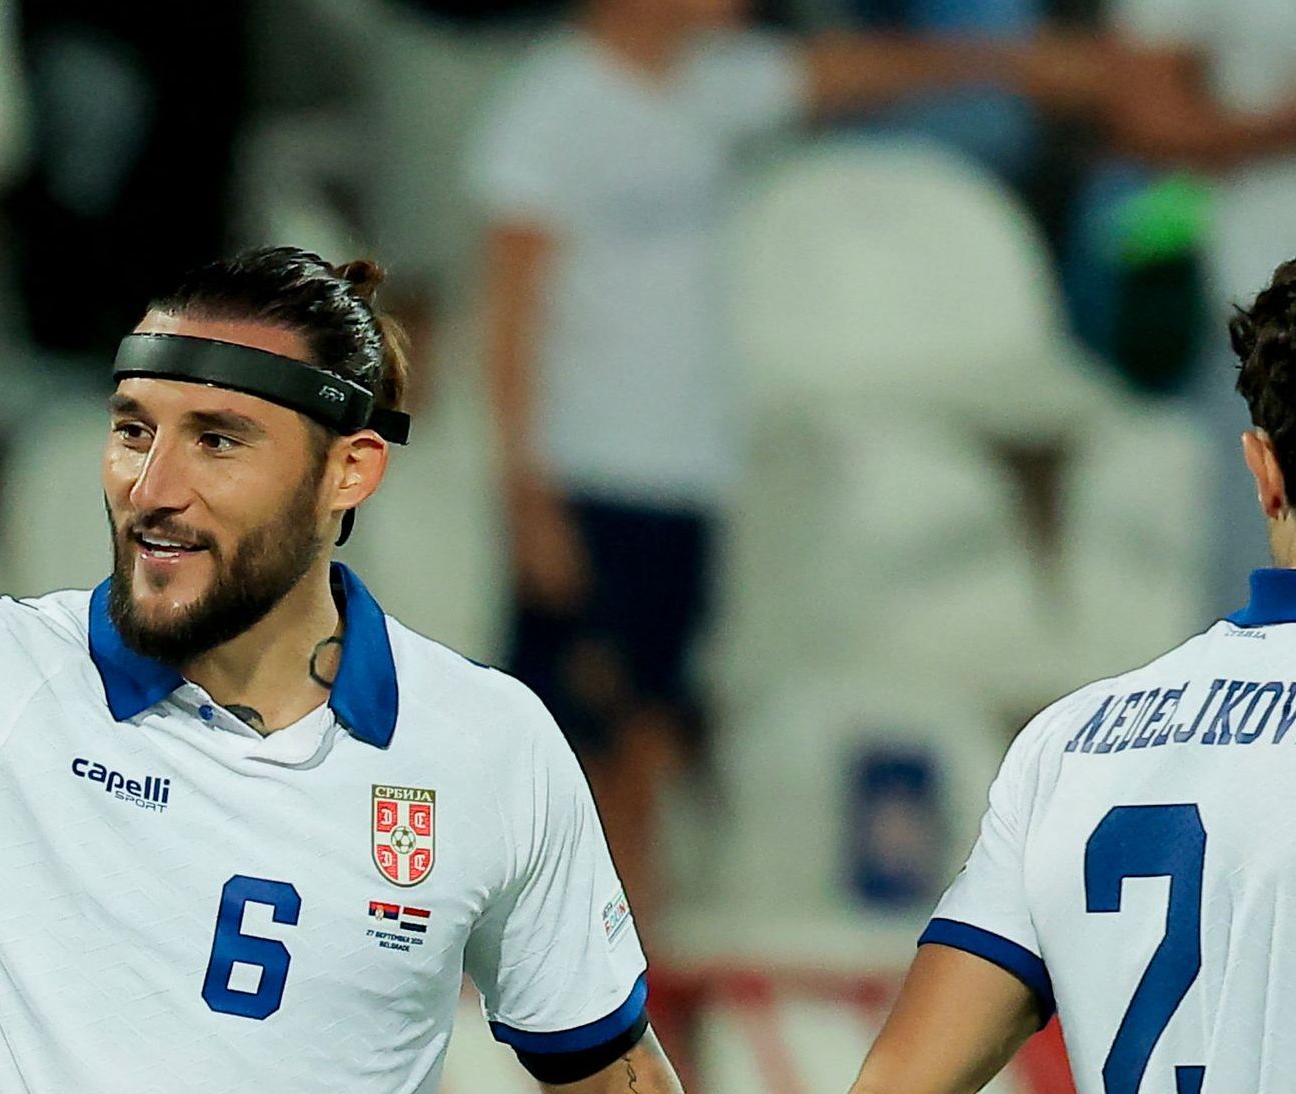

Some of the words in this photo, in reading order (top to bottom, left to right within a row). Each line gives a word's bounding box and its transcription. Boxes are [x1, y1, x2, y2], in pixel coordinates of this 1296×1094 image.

[72, 757, 171, 804] capelli
[374, 786, 434, 802] СРБИЈА
[114, 790, 168, 814] SPORT
[200, 873, 302, 1021] 6
